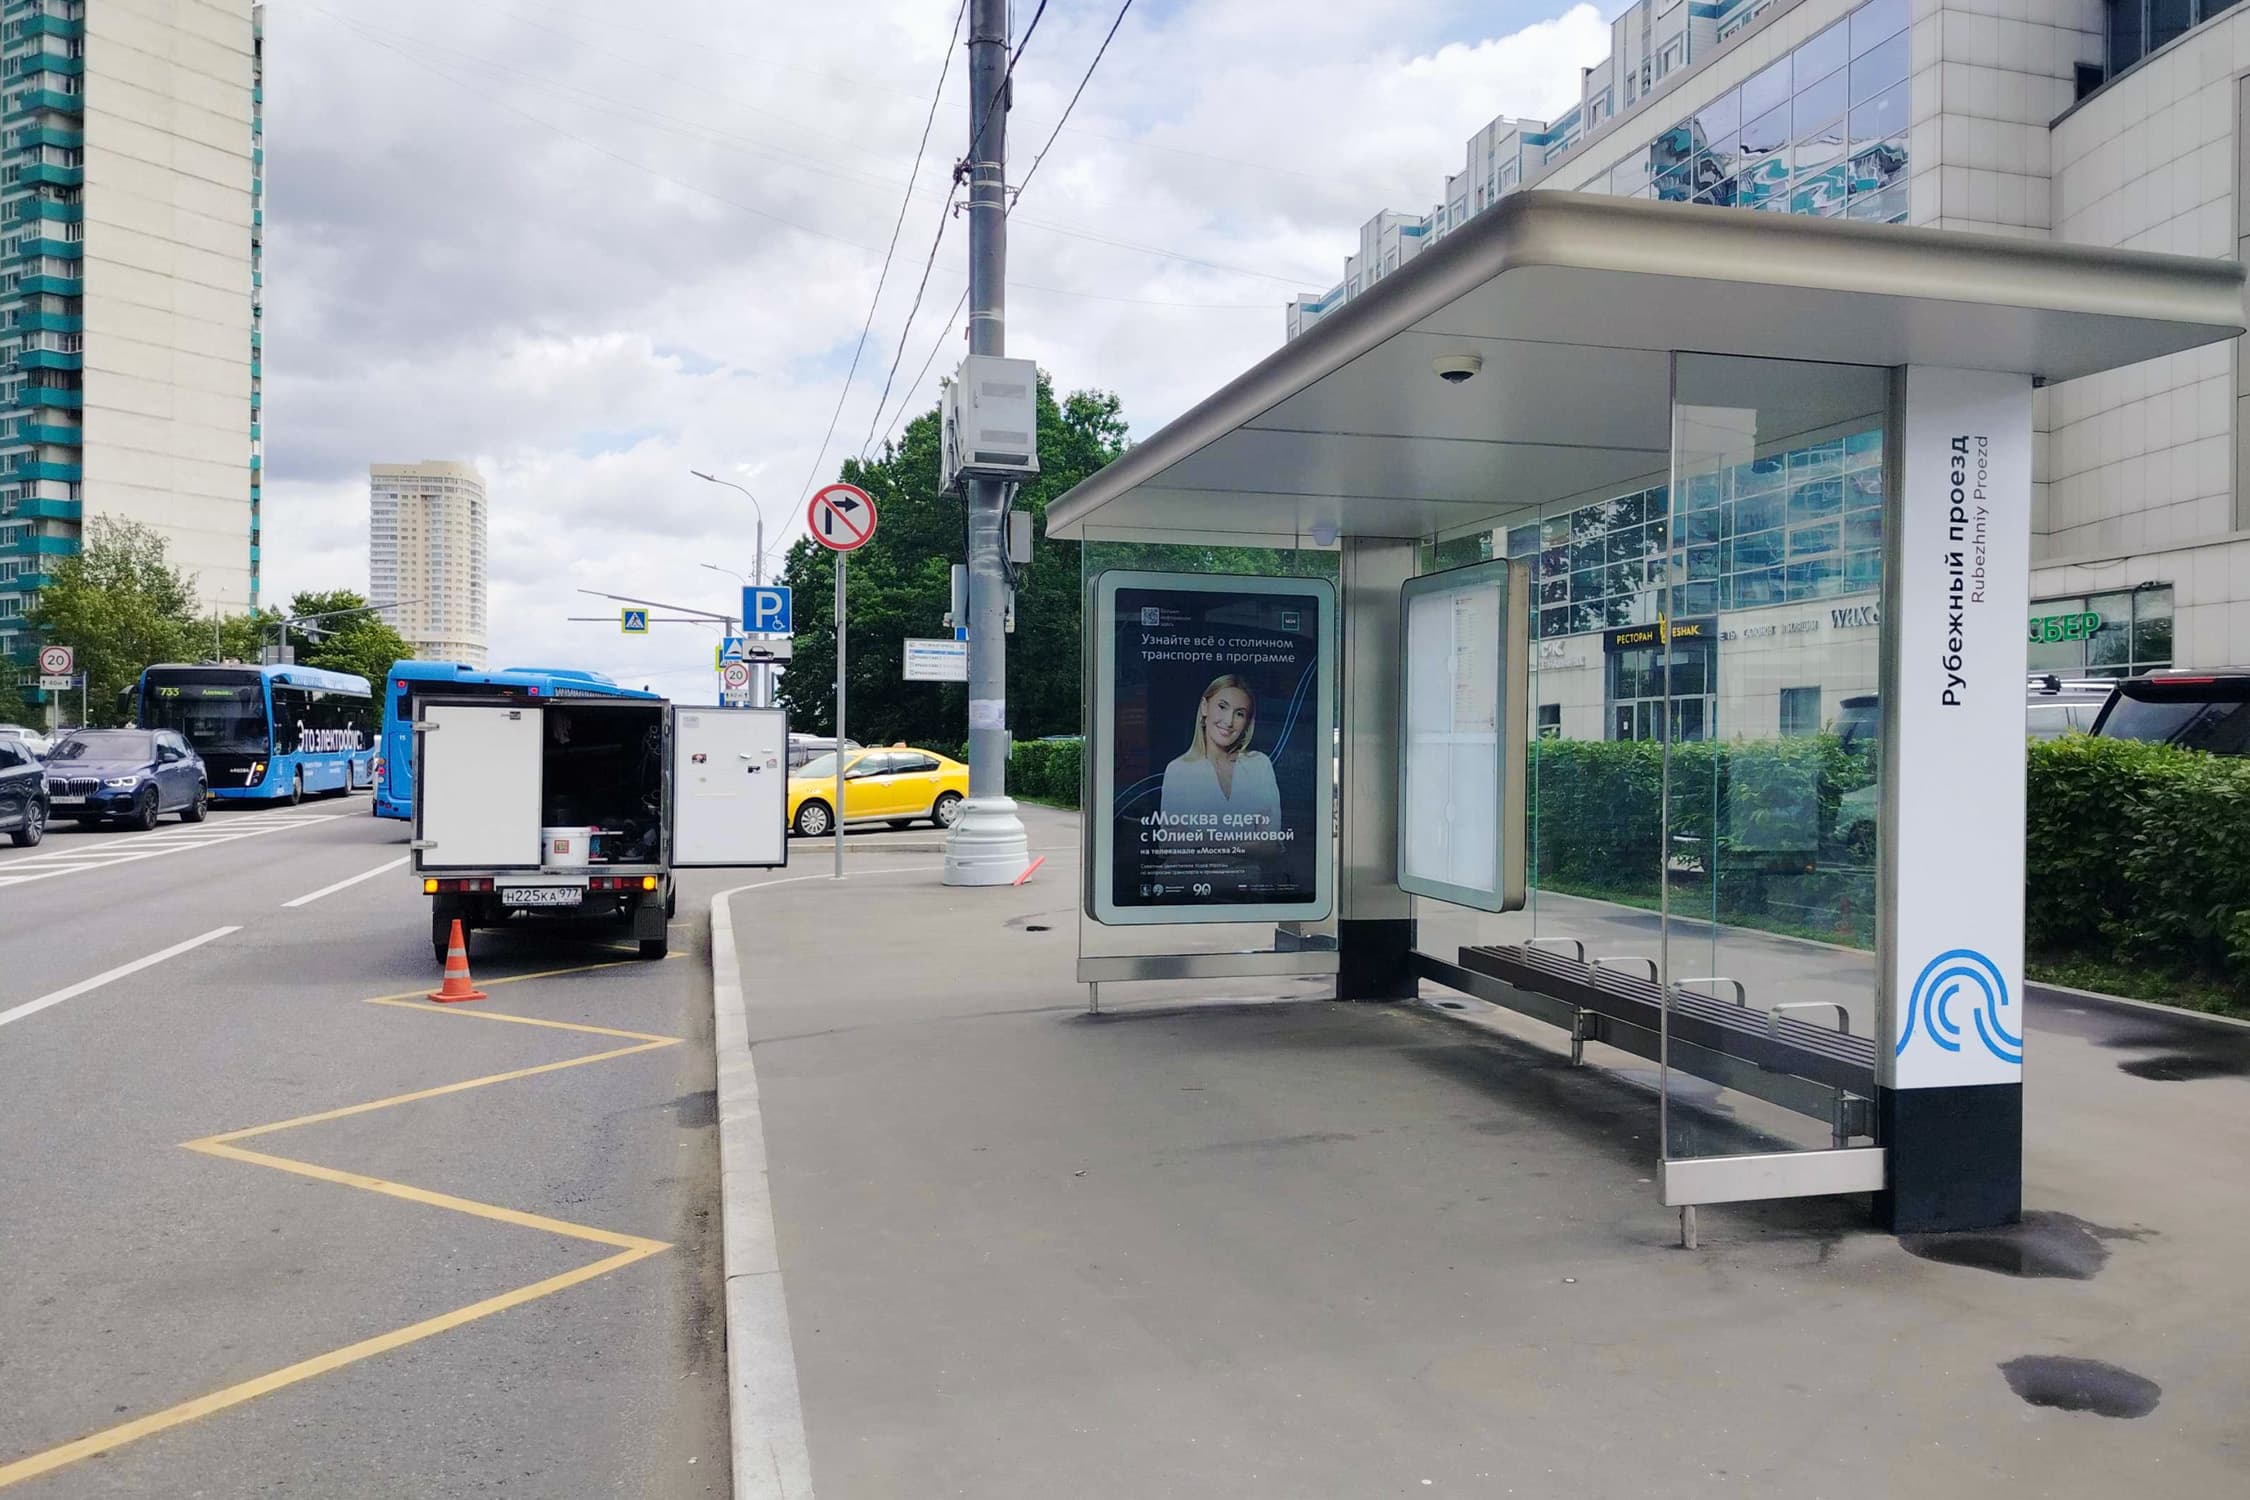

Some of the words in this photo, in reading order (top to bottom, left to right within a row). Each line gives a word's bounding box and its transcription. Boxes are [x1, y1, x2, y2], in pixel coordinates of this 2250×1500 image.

[1974, 436, 1988, 500] Proezd
[1950, 435, 1969, 541] проезд
[1971, 505, 1989, 603] Rubezhniy
[756, 591, 783, 628] P
[1942, 551, 1966, 706] Рубежный
[1141, 633, 1191, 646] Узнайте
[1194, 635, 1215, 646] всё
[1218, 638, 1226, 647] о
[1228, 638, 1294, 649] столичном
[1616, 632, 1653, 645] РЕСТОРАН
[47, 655, 65, 666] 20
[1141, 650, 1213, 663] транспорте
[1216, 653, 1223, 662] в
[1226, 654, 1295, 664] программе
[729, 671, 743, 680] 20
[160, 687, 180, 696] 733
[297, 719, 316, 753] Это
[1140, 811, 1218, 826] «Москва
[1222, 814, 1270, 827] едет»
[1140, 832, 1149, 842] с
[1152, 828, 1204, 842] Юлией
[1206, 829, 1295, 841] Темниковой
